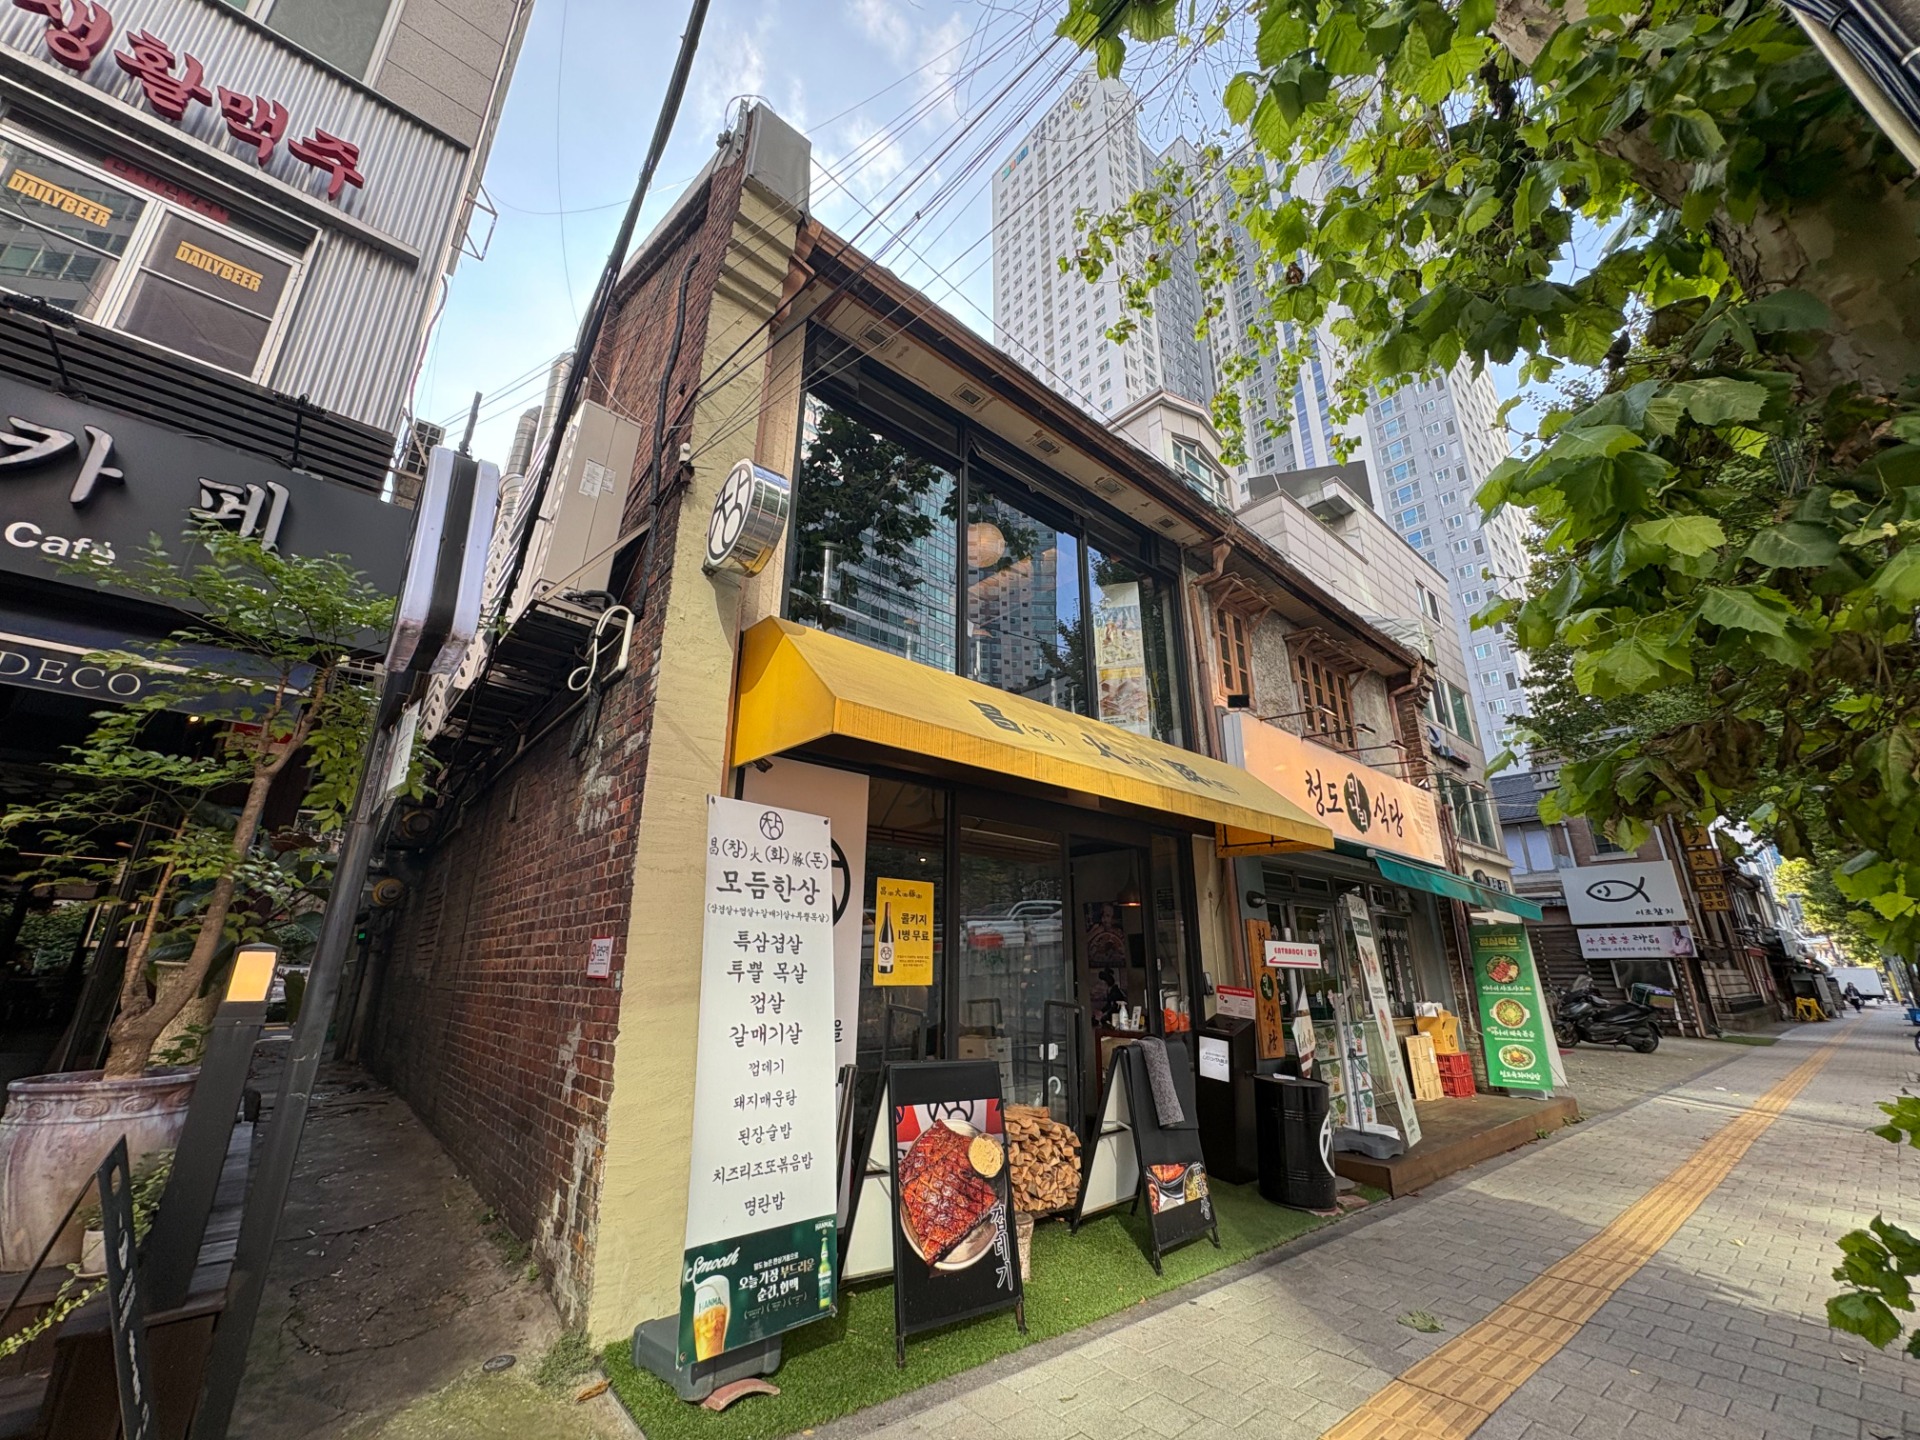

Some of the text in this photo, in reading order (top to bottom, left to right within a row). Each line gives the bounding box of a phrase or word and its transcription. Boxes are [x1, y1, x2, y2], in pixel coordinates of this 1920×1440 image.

[14, 0, 365, 200] 생활맥주
[7, 168, 113, 228] DAILYBEER
[174, 241, 263, 292] DAILYBEER
[1305, 768, 1344, 818] 청도
[1374, 792, 1404, 838] 식당
[716, 870, 821, 906] 모듬한상
[733, 930, 803, 955] 특삼겹살
[912, 930, 930, 942] 무료
[773, 962, 808, 984] 목살
[750, 991, 785, 1014] 껍살
[729, 1022, 803, 1048] 갈매기살
[747, 1058, 785, 1077] 껍데기
[733, 1089, 798, 1112] 돼지매운탕
[737, 1122, 793, 1145] 된장술밥
[711, 1151, 814, 1185] 치즈리조또볶음밥
[744, 1192, 785, 1217] 명란밥
[989, 1204, 1014, 1292] 껍데기
[684, 1246, 741, 1283] Smooth
[738, 1275, 759, 1291] 오늘
[759, 1267, 780, 1285] 가장
[698, 1296, 725, 1314] HANMA
